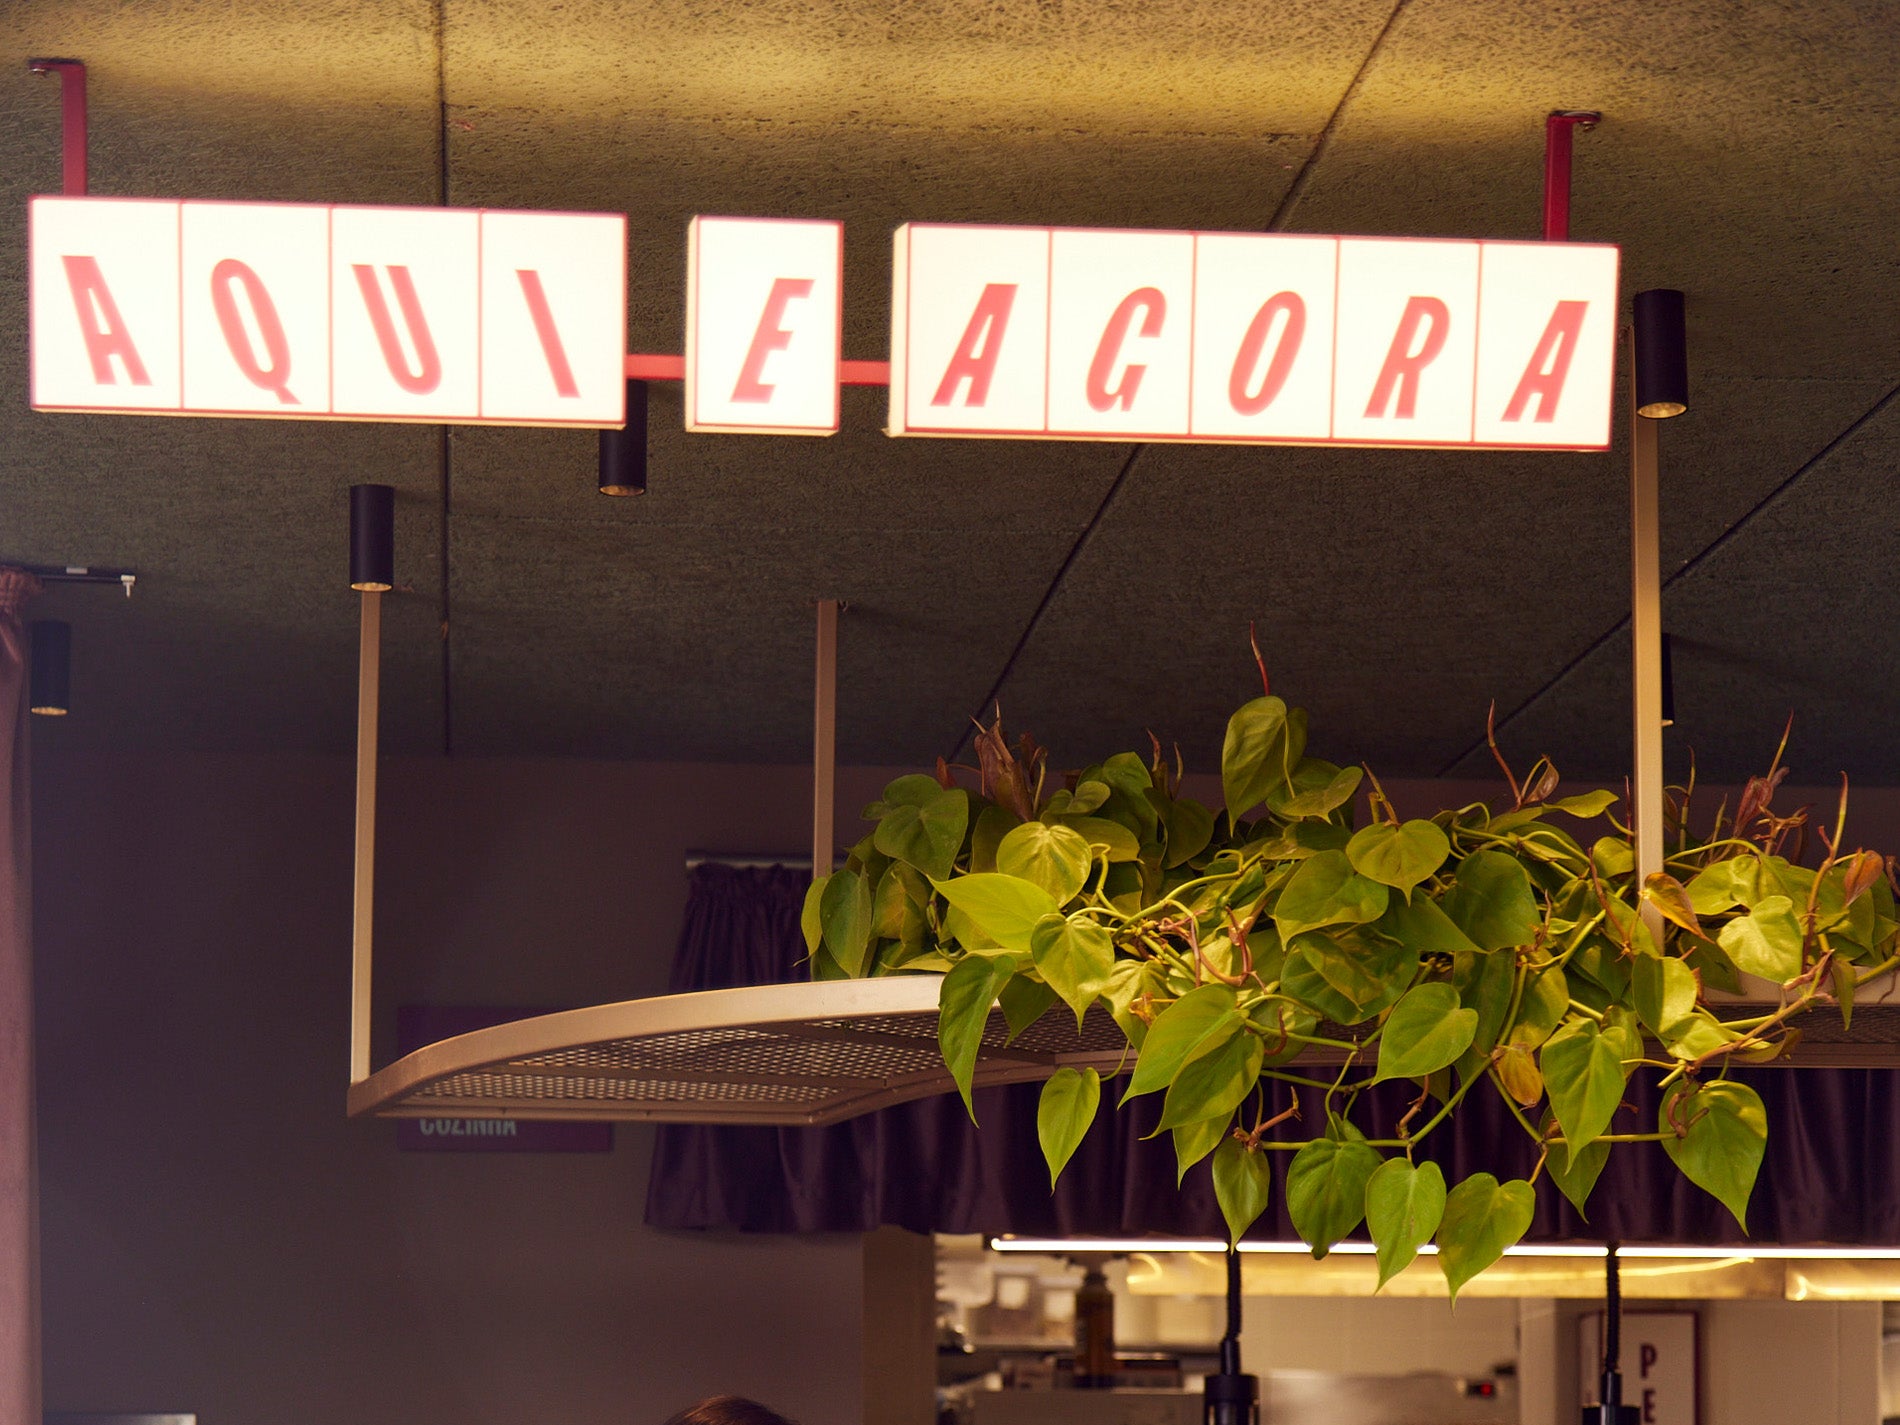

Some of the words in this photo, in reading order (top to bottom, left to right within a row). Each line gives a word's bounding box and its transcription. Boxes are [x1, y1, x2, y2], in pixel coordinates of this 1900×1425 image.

[61, 255, 581, 405] AQUI
[730, 278, 815, 404] E
[930, 282, 1590, 424] AGORA
